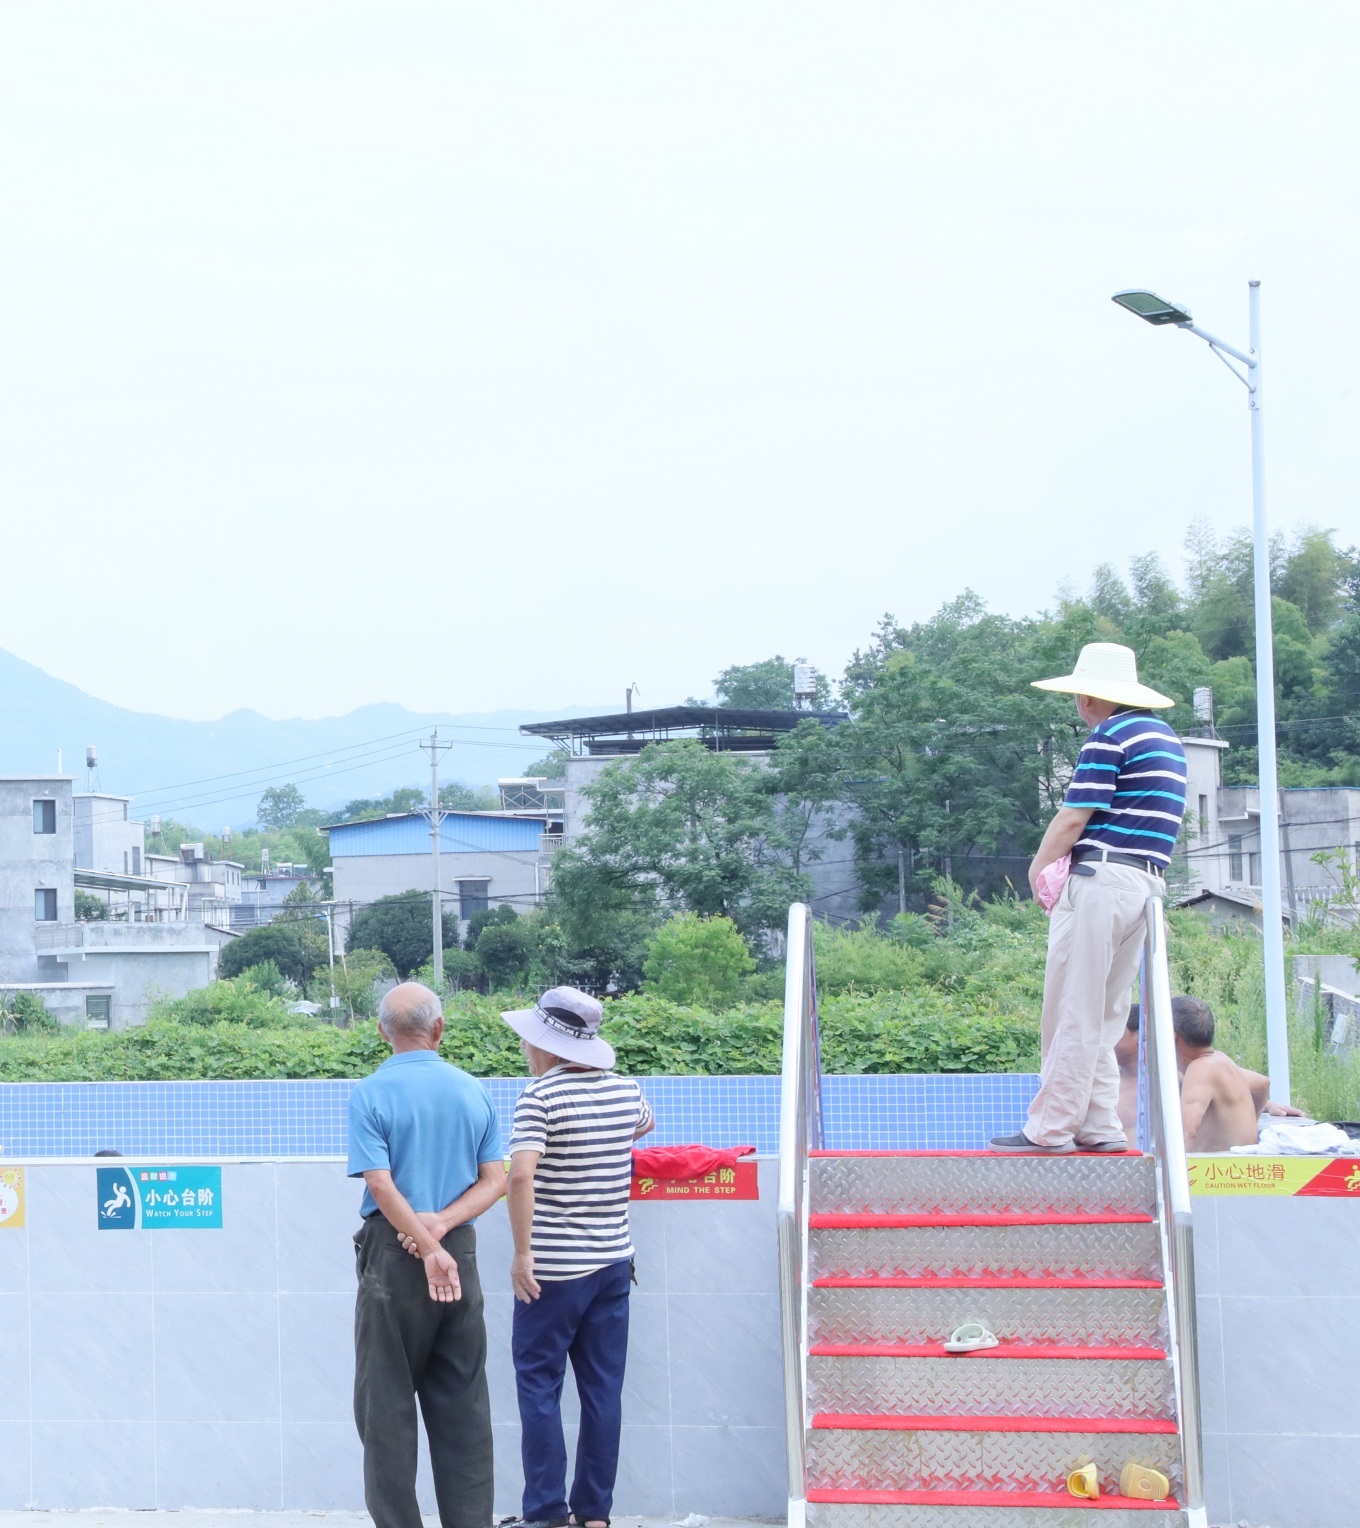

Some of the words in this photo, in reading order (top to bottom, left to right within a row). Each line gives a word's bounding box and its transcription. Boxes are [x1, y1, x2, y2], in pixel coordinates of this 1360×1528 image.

[1205, 1163, 1285, 1181] 小心地滑
[145, 1188, 214, 1206] 小心台阶
